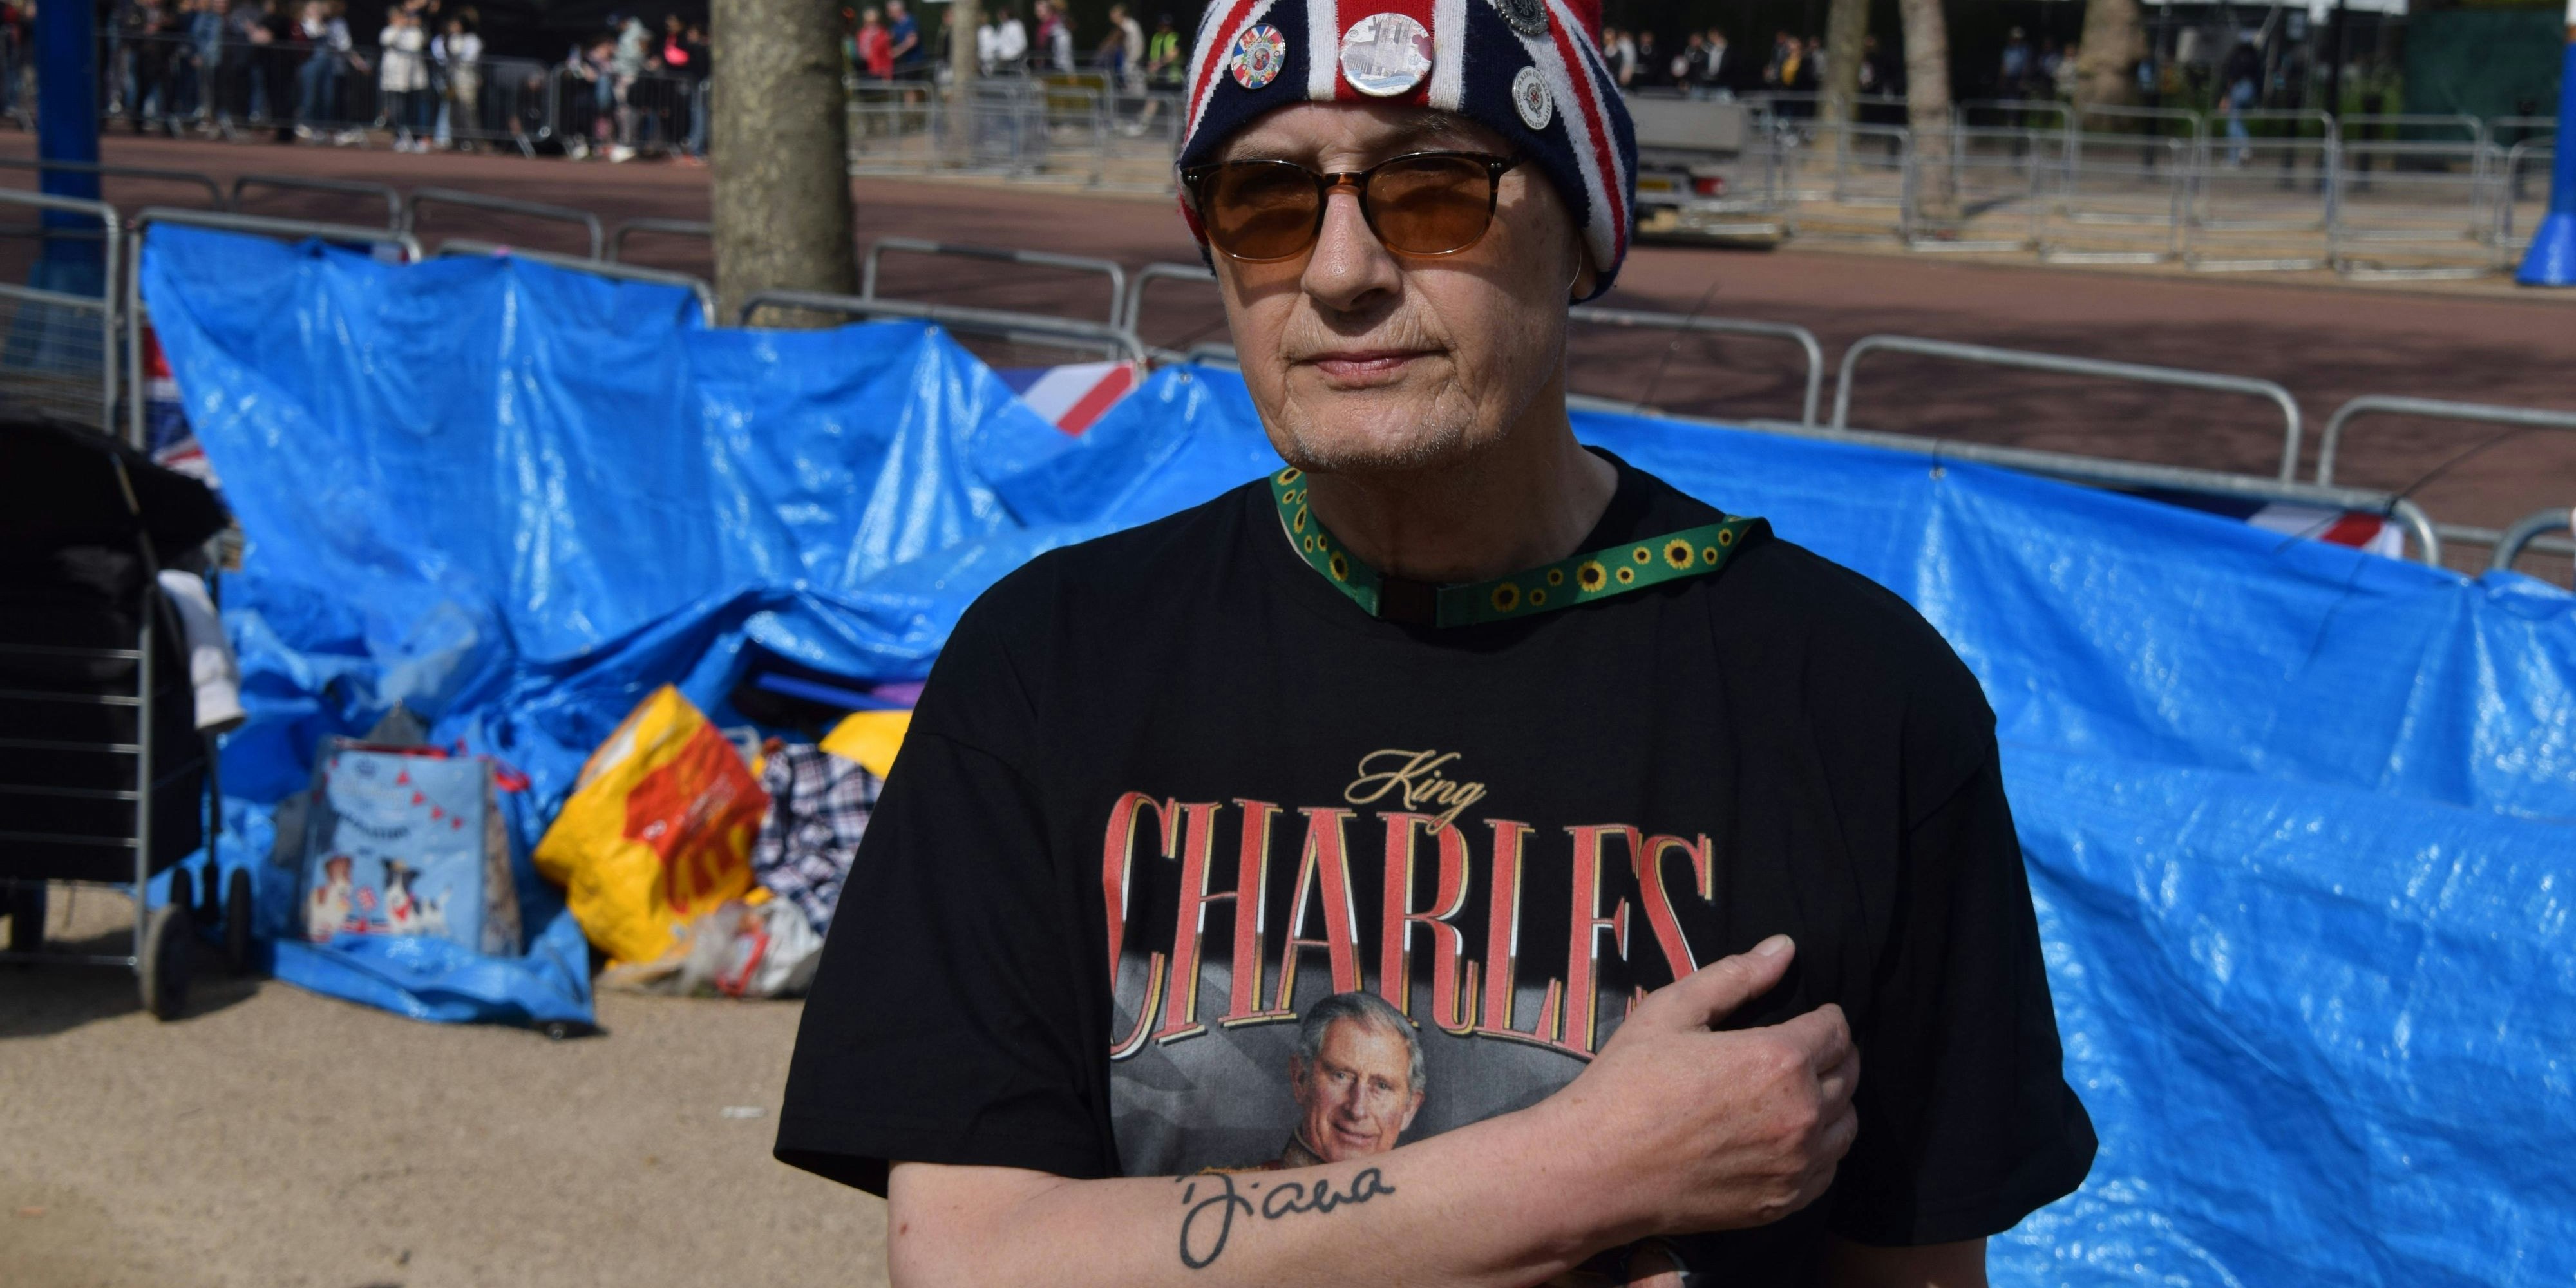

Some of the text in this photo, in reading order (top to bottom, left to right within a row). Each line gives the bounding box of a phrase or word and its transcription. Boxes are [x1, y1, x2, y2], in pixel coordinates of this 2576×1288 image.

[1520, 70, 1532, 81] KING
[1532, 71, 1551, 102] CHARLES
[1343, 748, 1488, 835] King
[1102, 790, 1713, 1061] CHARLES
[1175, 1167, 1396, 1270] Diana
